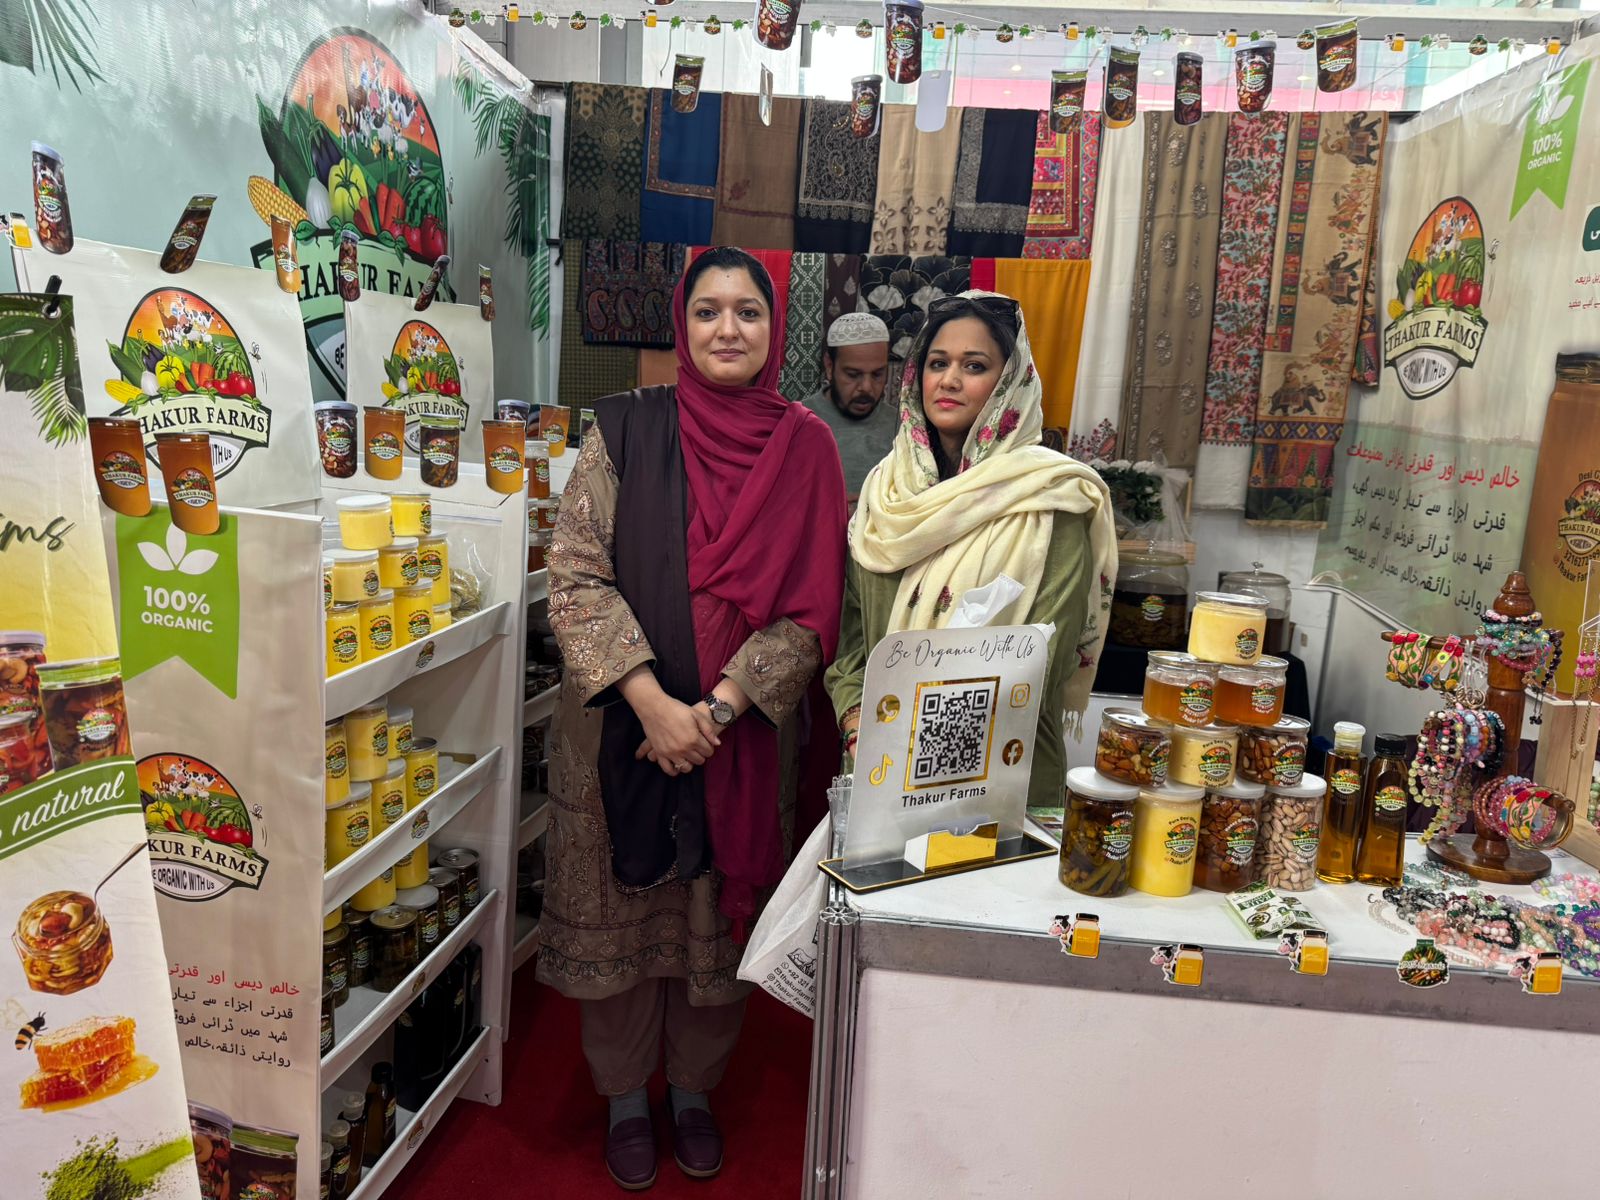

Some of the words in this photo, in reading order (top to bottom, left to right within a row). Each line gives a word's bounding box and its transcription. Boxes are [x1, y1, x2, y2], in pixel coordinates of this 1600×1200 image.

[1532, 130, 1562, 156] 100%
[1528, 151, 1562, 170] ORGANIC
[1387, 320, 1431, 353] THAKUR
[1433, 320, 1478, 350] FARMS
[140, 407, 202, 434] HAKUR
[206, 407, 265, 433] FARMS
[224, 448, 232, 461] US
[1405, 452, 1434, 475] قدرتی
[1439, 456, 1457, 480] اور
[1459, 468, 1485, 486] دیسی
[1490, 466, 1520, 488] خالص
[1403, 489, 1423, 512] تیار
[1426, 503, 1441, 516] سے
[1474, 511, 1506, 533] قدرتی
[1453, 550, 1467, 565] میں
[1473, 554, 1492, 575] شہد
[143, 585, 210, 616] 100%
[141, 611, 214, 633] ORGANIC
[885, 640, 912, 668] Be
[915, 639, 976, 667] Organic
[980, 635, 1014, 662] With
[1016, 635, 1036, 659] Us
[12, 770, 125, 836] natural
[902, 791, 946, 808] Thakur
[950, 786, 987, 801] Farms
[148, 838, 186, 856] KUR
[191, 845, 258, 878] FARMS
[158, 868, 188, 891] ORGANIC
[188, 869, 206, 891] WITH
[206, 879, 215, 890] US
[207, 970, 225, 985] اور
[235, 979, 263, 992] دیسی
[172, 987, 196, 1002] تیار
[270, 981, 300, 996] خالص
[773, 980, 794, 999] Thakur
[794, 997, 811, 1014] Farms
[202, 998, 217, 1007] سے
[224, 997, 253, 1013] اجزاء
[261, 1006, 294, 1020] قدرتی
[202, 1017, 234, 1033] ڈرائی
[240, 1027, 261, 1038] میں
[268, 1030, 288, 1044] شہد
[252, 1051, 291, 1068] روایتی
